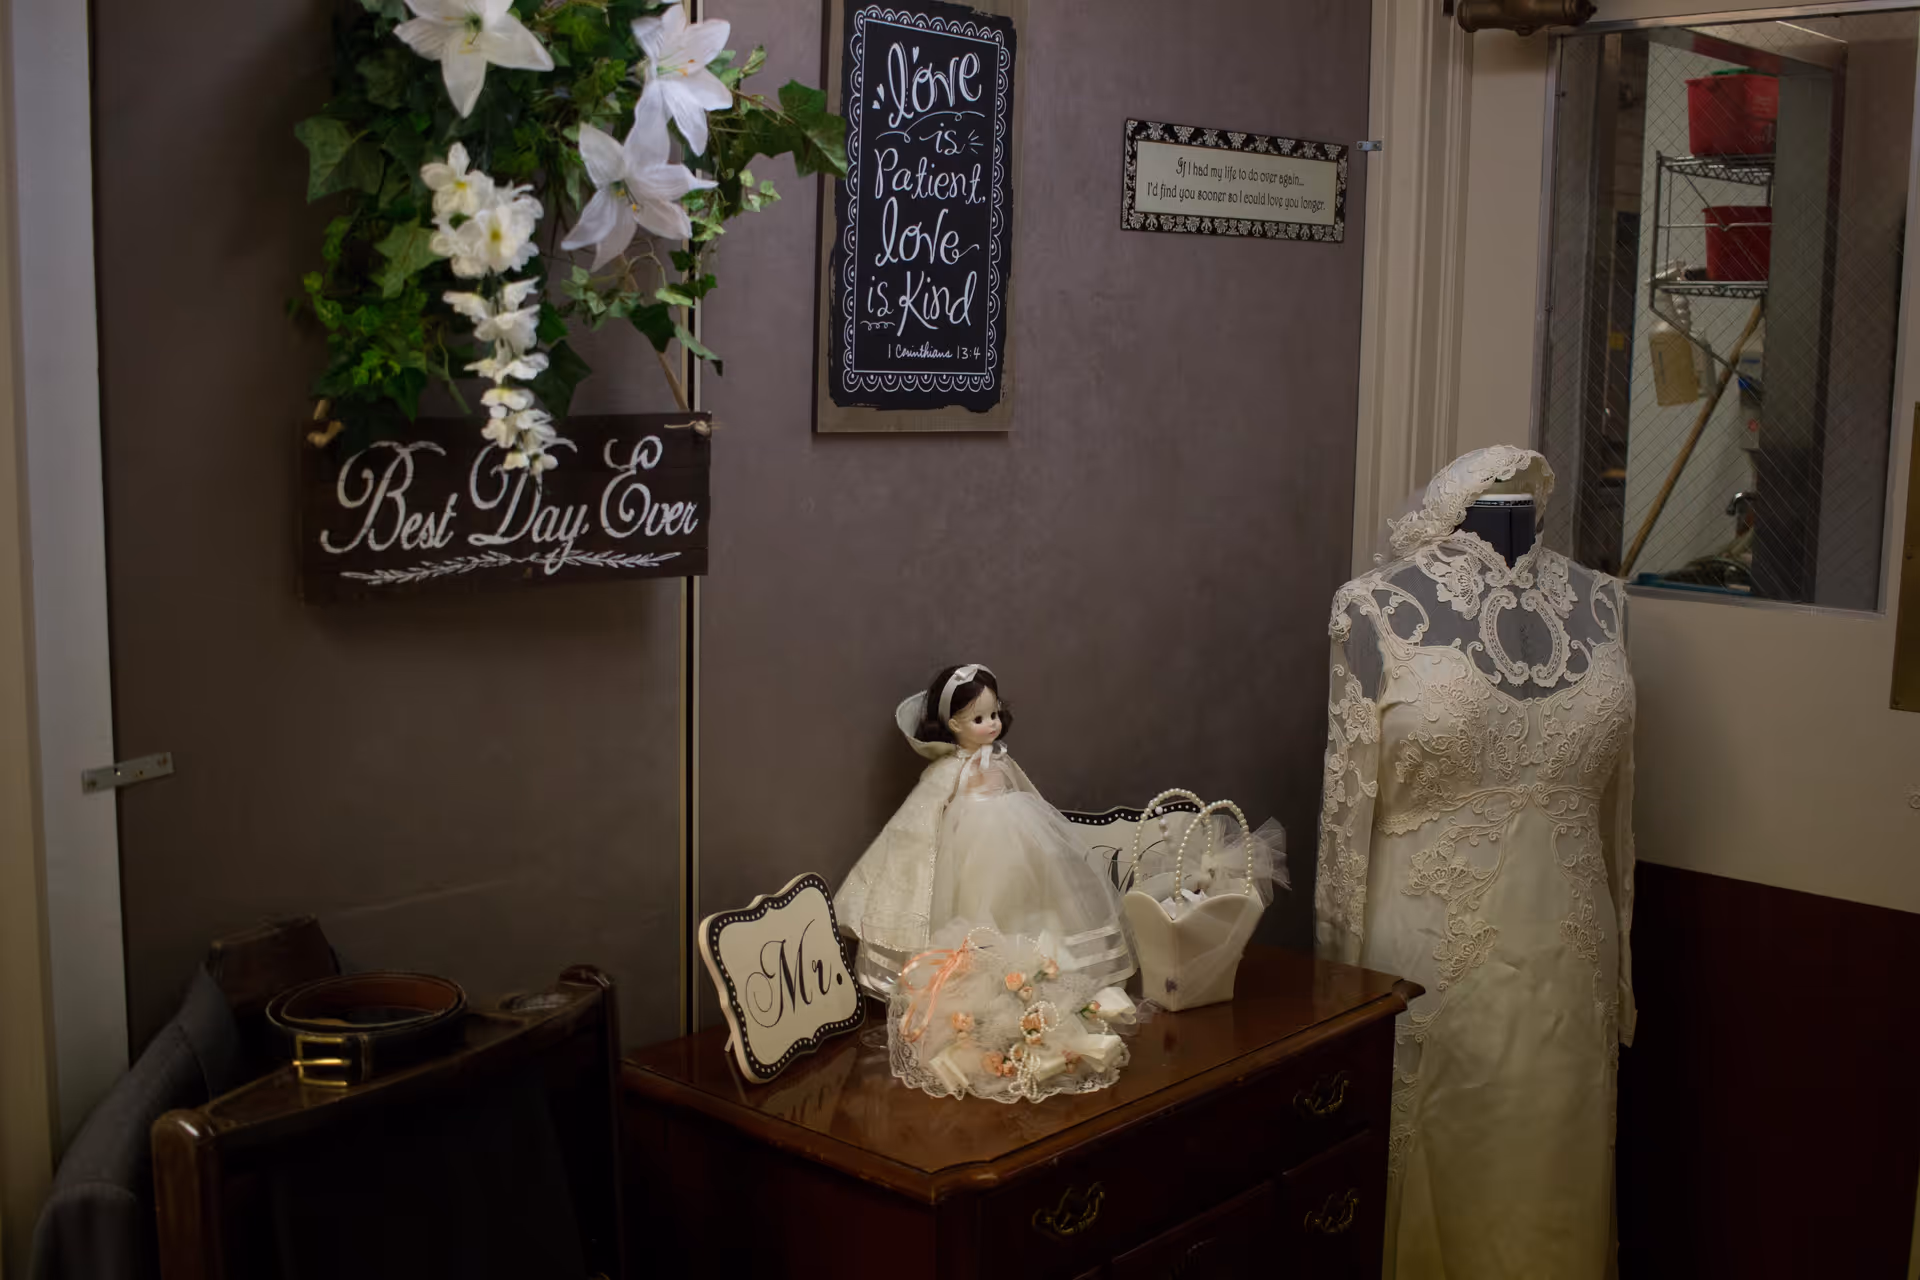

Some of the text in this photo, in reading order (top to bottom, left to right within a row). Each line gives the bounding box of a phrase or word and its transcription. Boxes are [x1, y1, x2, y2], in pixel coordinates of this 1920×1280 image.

[919, 122, 966, 156] is
[1192, 162, 1209, 177] had
[1210, 166, 1224, 182] my
[1224, 165, 1237, 182] life
[1238, 167, 1247, 181] to
[1248, 168, 1259, 182] do
[1260, 172, 1278, 184] over
[1147, 181, 1159, 197] I'd
[1160, 182, 1177, 201] find
[1178, 188, 1196, 203] you
[1197, 189, 1227, 203] sooner
[1227, 192, 1239, 204] so
[1243, 191, 1266, 206] could
[1267, 193, 1284, 208] love
[1284, 196, 1299, 211] you
[874, 196, 980, 267] love
[867, 275, 895, 317] is
[887, 340, 981, 360] 1 Corinthians 13:4
[319, 440, 460, 554] Best
[600, 435, 700, 539] Ever
[745, 918, 843, 1029] Mr.
